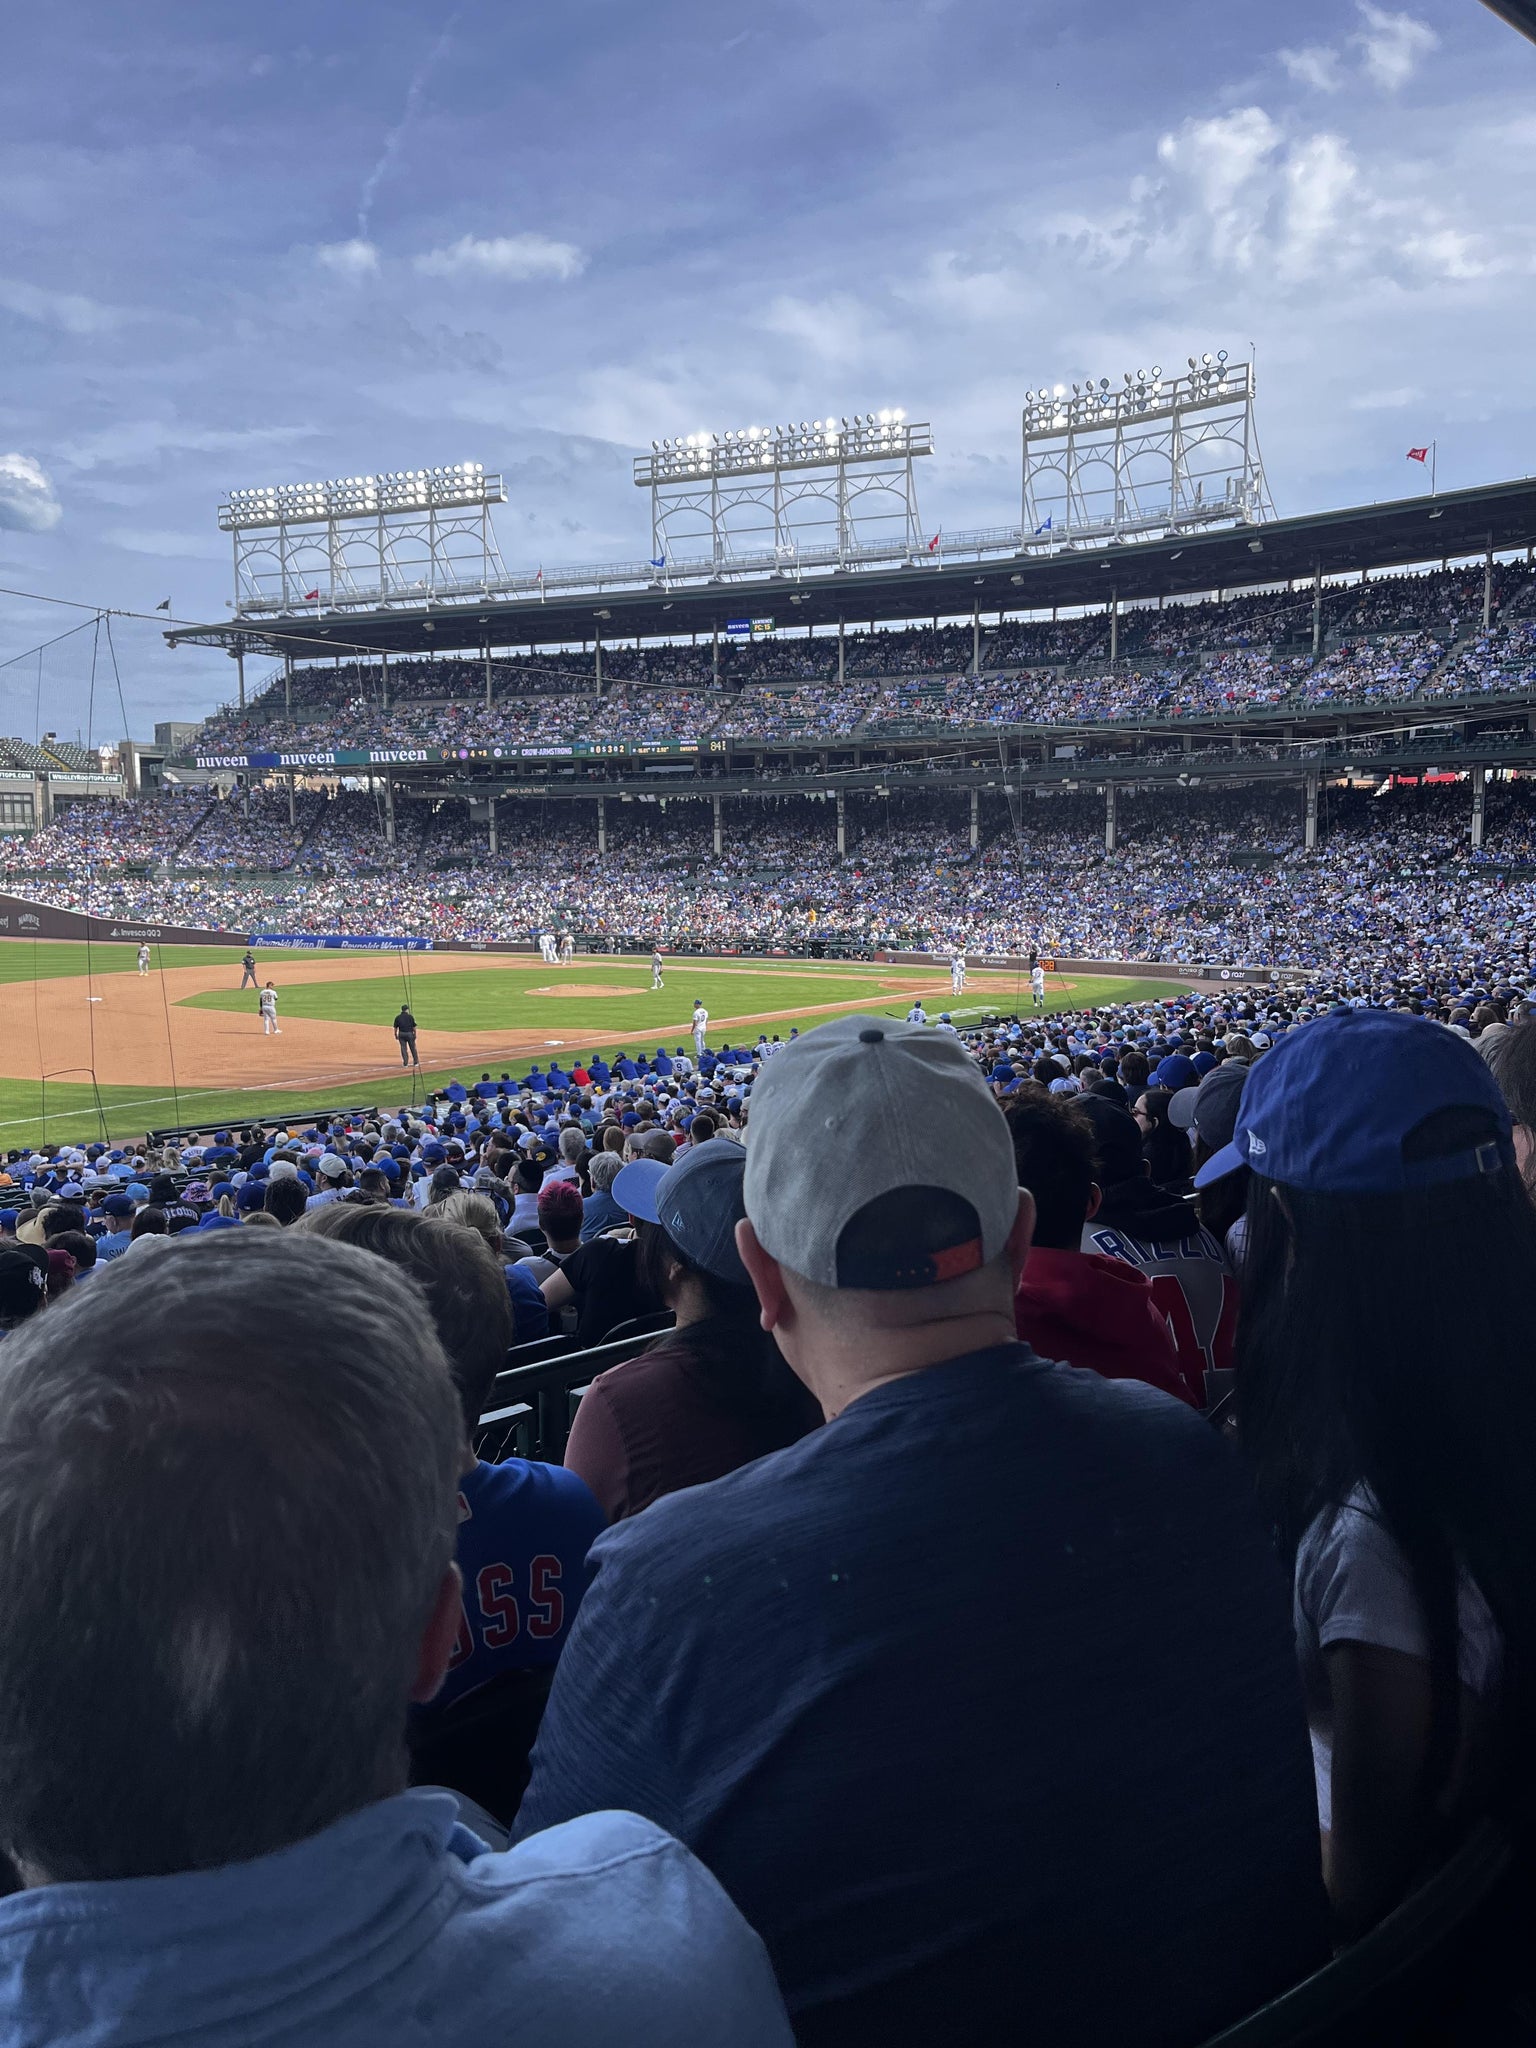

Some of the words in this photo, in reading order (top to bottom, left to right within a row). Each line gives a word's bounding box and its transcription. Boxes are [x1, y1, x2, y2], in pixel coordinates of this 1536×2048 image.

[710, 741, 721, 751] 84
[370, 749, 428, 763] nuveen
[522, 747, 572, 756] CROW-ARMSTRONG
[196, 755, 248, 768] nuveen
[280, 752, 336, 765] nuveen
[18, 912, 40, 927] MARQUEE
[256, 937, 292, 947] Reynolds
[341, 941, 380, 949] Reynolds
[676, 1063, 682, 1072] 9
